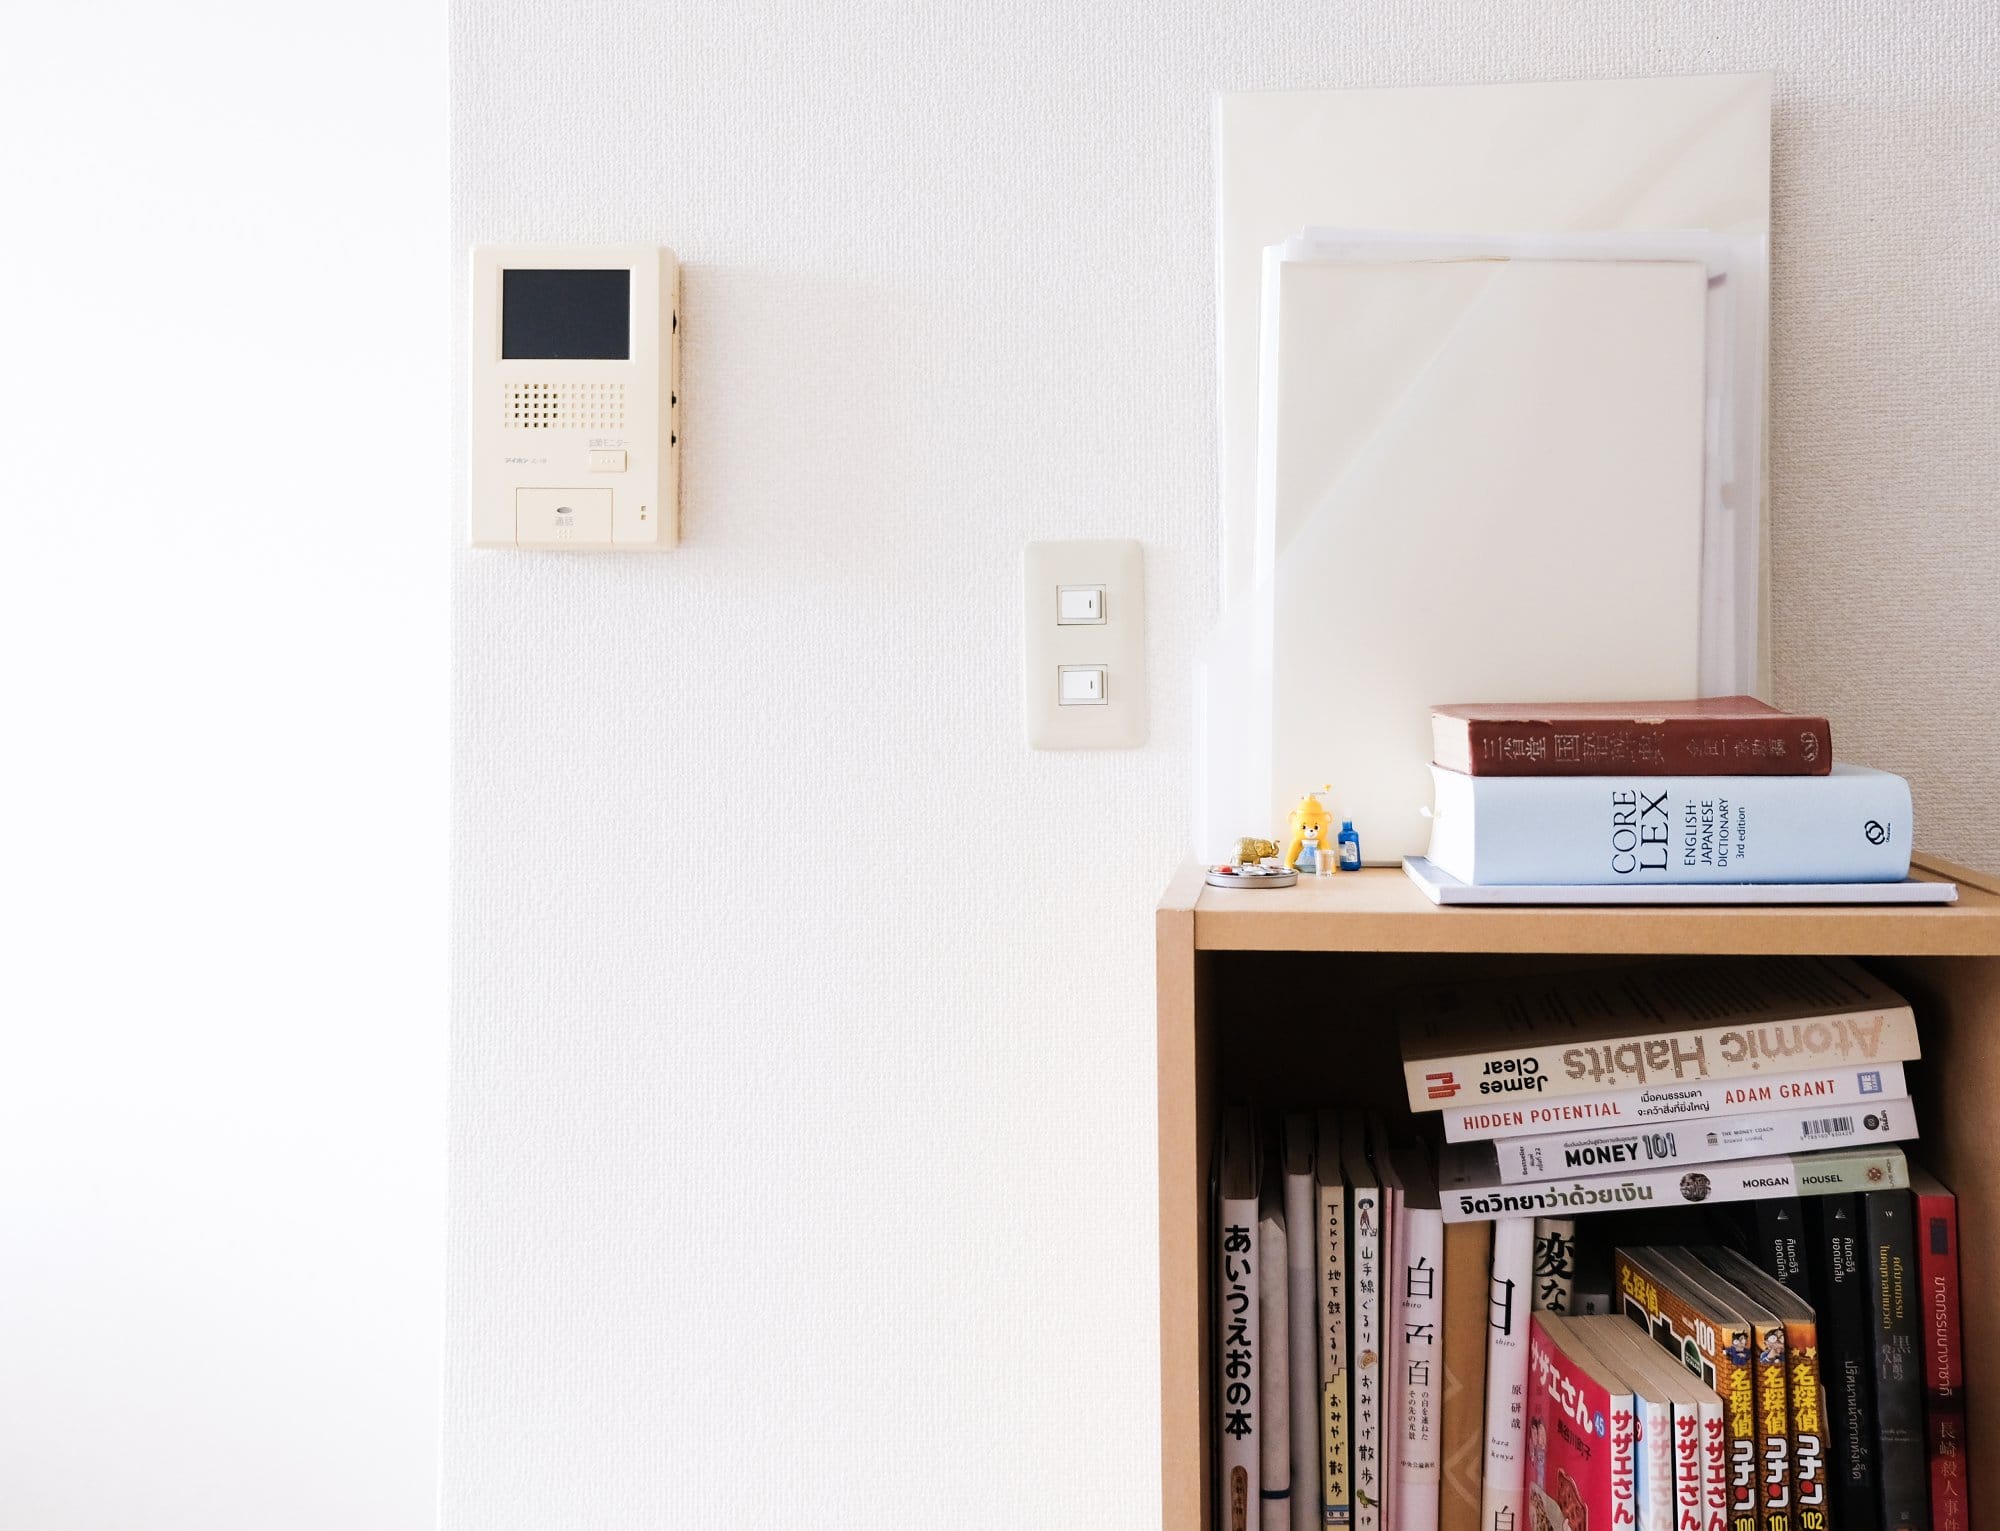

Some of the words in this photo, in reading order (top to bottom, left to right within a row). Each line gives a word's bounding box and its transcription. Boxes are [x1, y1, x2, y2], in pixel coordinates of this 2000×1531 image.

[1482, 737, 1546, 762] 三省堂
[1612, 789, 1637, 874] CORE
[1640, 789, 1668, 872] LEX
[1684, 800, 1697, 866] ENGLISH-
[1701, 800, 1713, 866] JAPANESE
[1718, 798, 1729, 867] DICTIONARY
[1736, 807, 1746, 842] edition
[1736, 843, 1745, 859] 3rd
[1563, 1034, 1706, 1085] Habits
[1720, 1015, 1884, 1064] Atomic
[1479, 1075, 1548, 1095] James
[1483, 1057, 1539, 1075] Clear
[1464, 1111, 1523, 1131] HIDDEN
[1531, 1101, 1621, 1124] POTENTIAL
[1725, 1087, 1773, 1105] ADAM
[1780, 1080, 1836, 1099] GRANT
[1565, 1142, 1638, 1168] MONEY
[1643, 1132, 1678, 1159] 101
[1460, 1182, 1654, 1216] จิตวิทยาว่าด้วยเงิน
[1742, 1176, 1790, 1189] MORGAN
[1802, 1173, 1843, 1186] HOUSEL
[1359, 1246, 1375, 1343] 山手線ぐるり
[1405, 1256, 1435, 1300] 白
[1535, 1232, 1575, 1312] 変な
[1620, 1264, 1661, 1318] 名探偵
[1224, 1223, 1253, 1441] あいうえおの本
[1695, 1317, 1715, 1356] 100
[1511, 1384, 1522, 1430] 原研哉
[1531, 1336, 1593, 1435] サザエさん
[1328, 1394, 1344, 1497] おみやげ散歩
[1358, 1375, 1375, 1486] おみやげ散歩
[1612, 1410, 1634, 1526] サザエさん
[1677, 1415, 1701, 1531] サザエさん
[1704, 1418, 1727, 1531] サザエさん
[1734, 1517, 1755, 1531] 100
[1768, 1515, 1789, 1531] 101
[1801, 1511, 1824, 1531] 102
